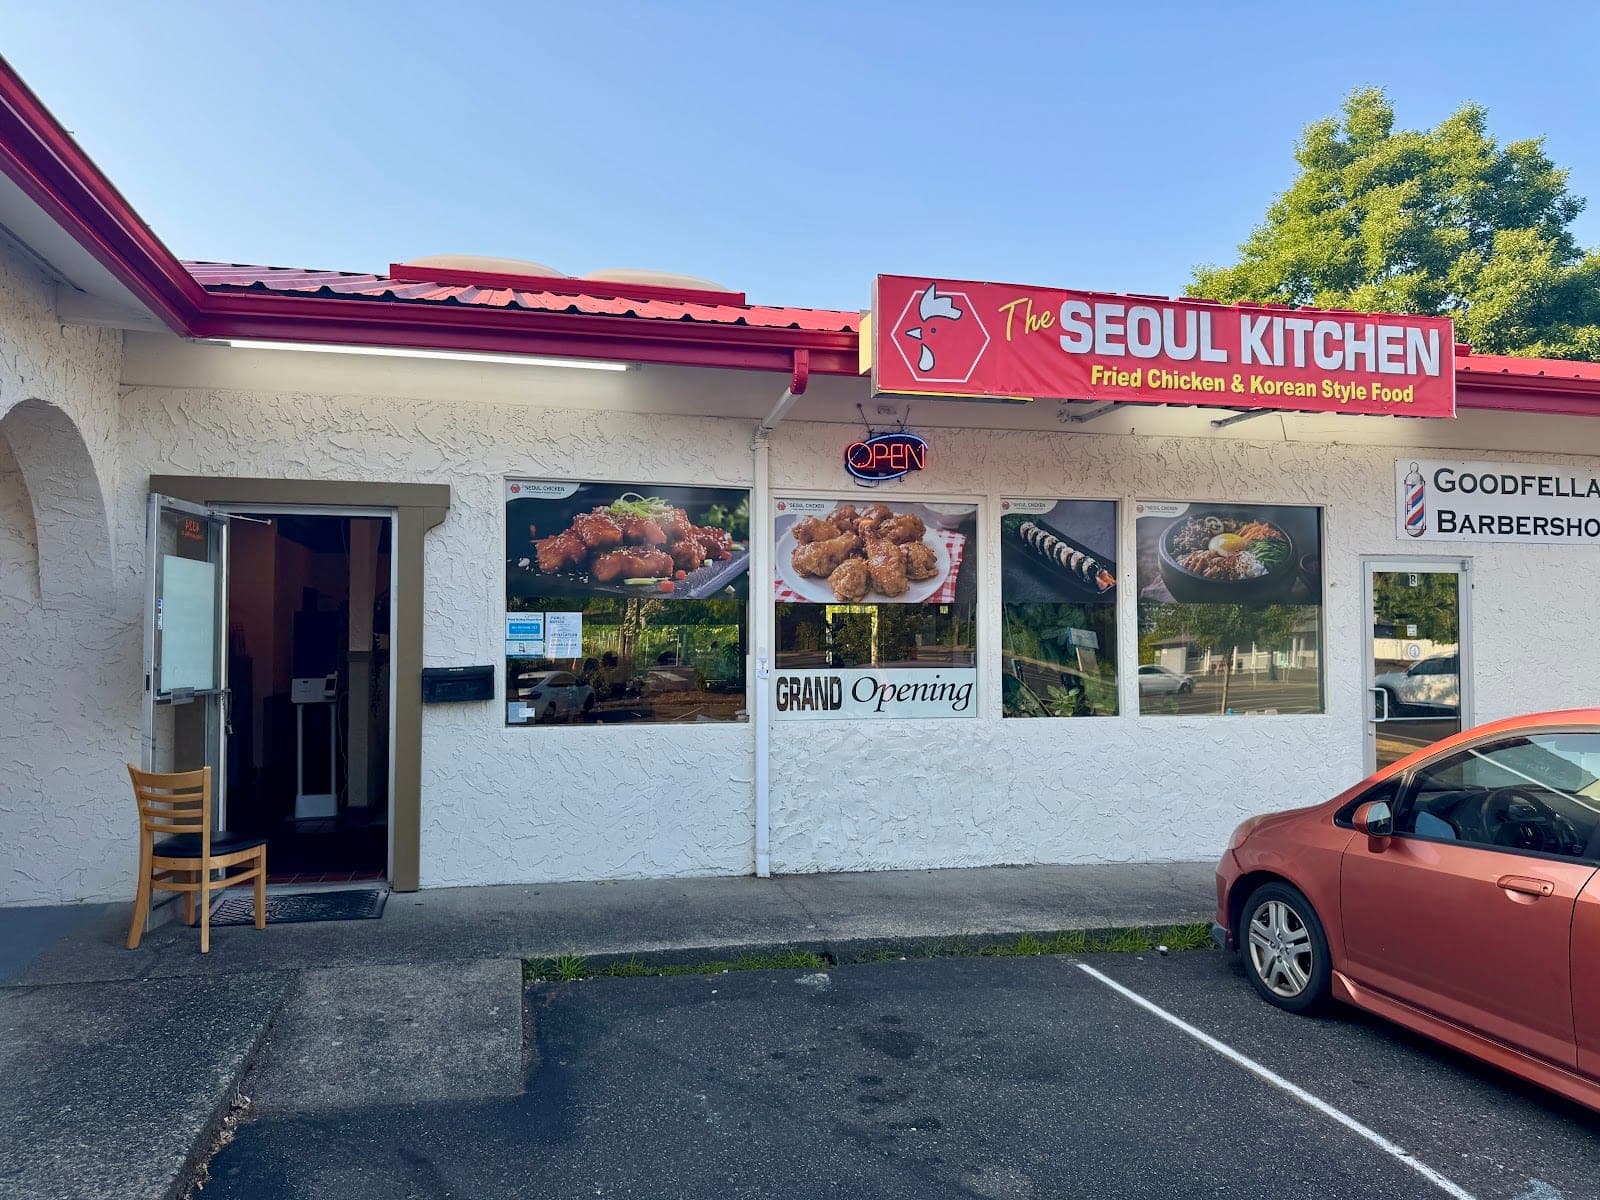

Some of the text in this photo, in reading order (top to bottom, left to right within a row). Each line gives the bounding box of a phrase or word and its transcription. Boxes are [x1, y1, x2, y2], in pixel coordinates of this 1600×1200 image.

[998, 297, 1440, 377] The SEOUL KITCHEN
[1091, 364, 1414, 404] Fried Chicken & Korean Style Food
[847, 442, 926, 470] OPEN
[1437, 510, 1600, 538] BARBERSHO
[776, 674, 974, 713] GRAND Opening
